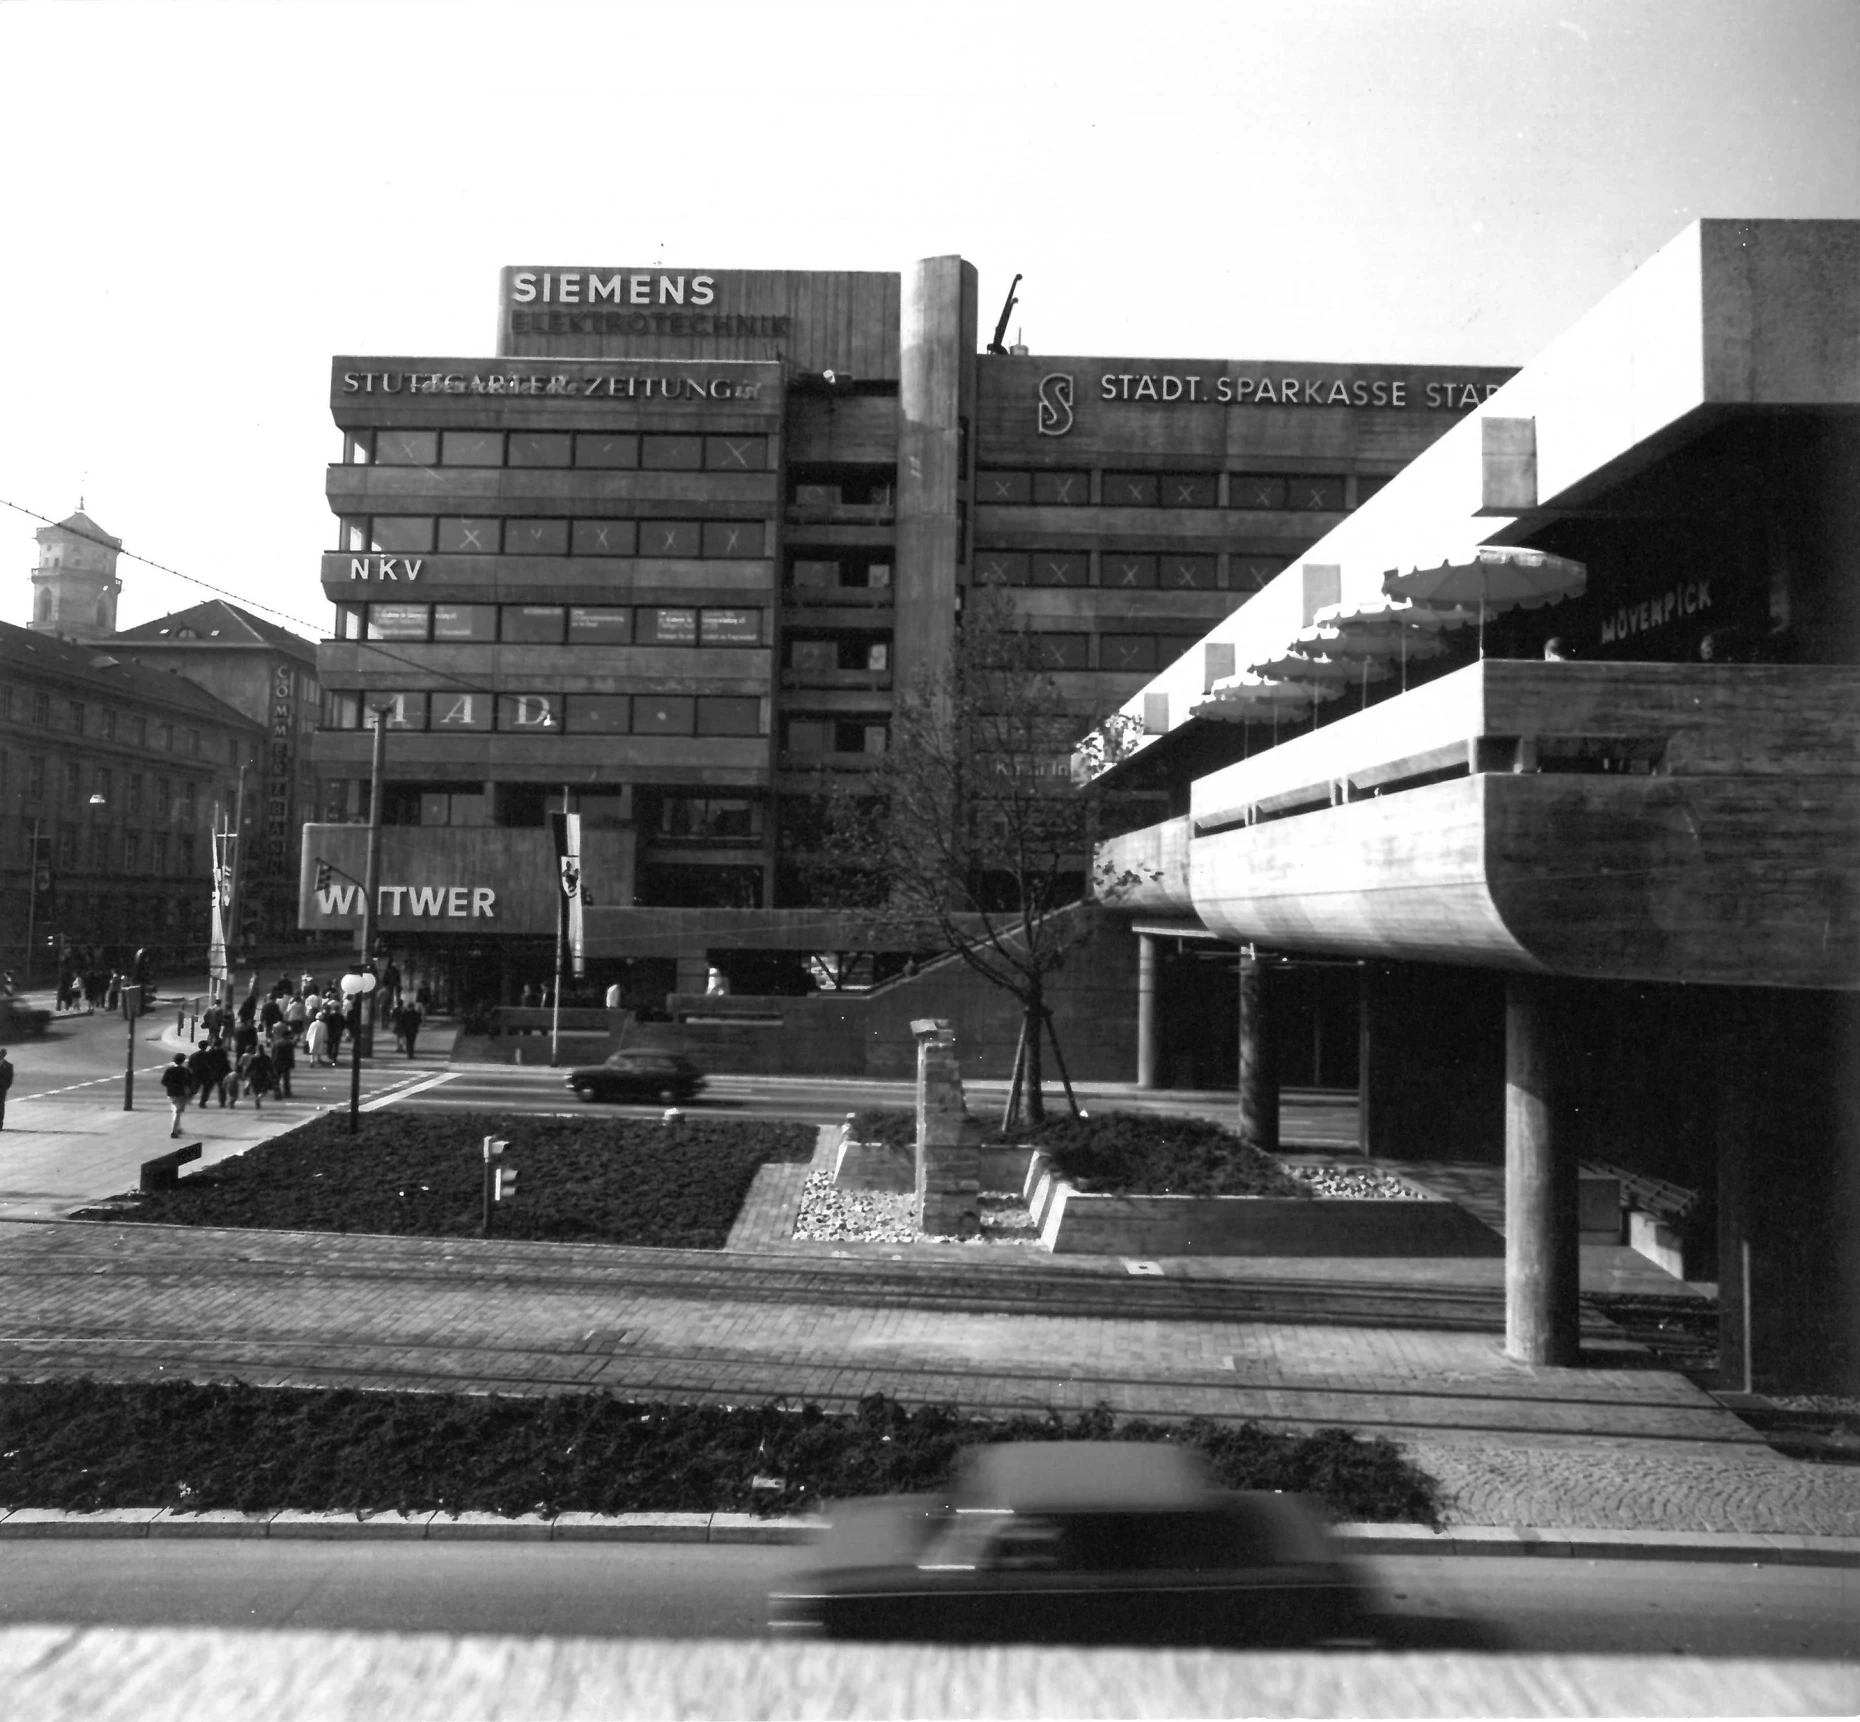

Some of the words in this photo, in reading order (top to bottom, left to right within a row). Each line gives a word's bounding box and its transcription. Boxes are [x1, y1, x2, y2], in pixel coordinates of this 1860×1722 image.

[513, 272, 715, 305] SIEMENS
[511, 309, 790, 338] ELEKTROTECHNIK
[343, 371, 572, 396] STUTTGARTER
[583, 376, 732, 398] ZEITUNG
[1101, 374, 1207, 402] STÄDT.
[1217, 376, 1406, 407] SPARKASSE
[351, 558, 422, 581] NKV
